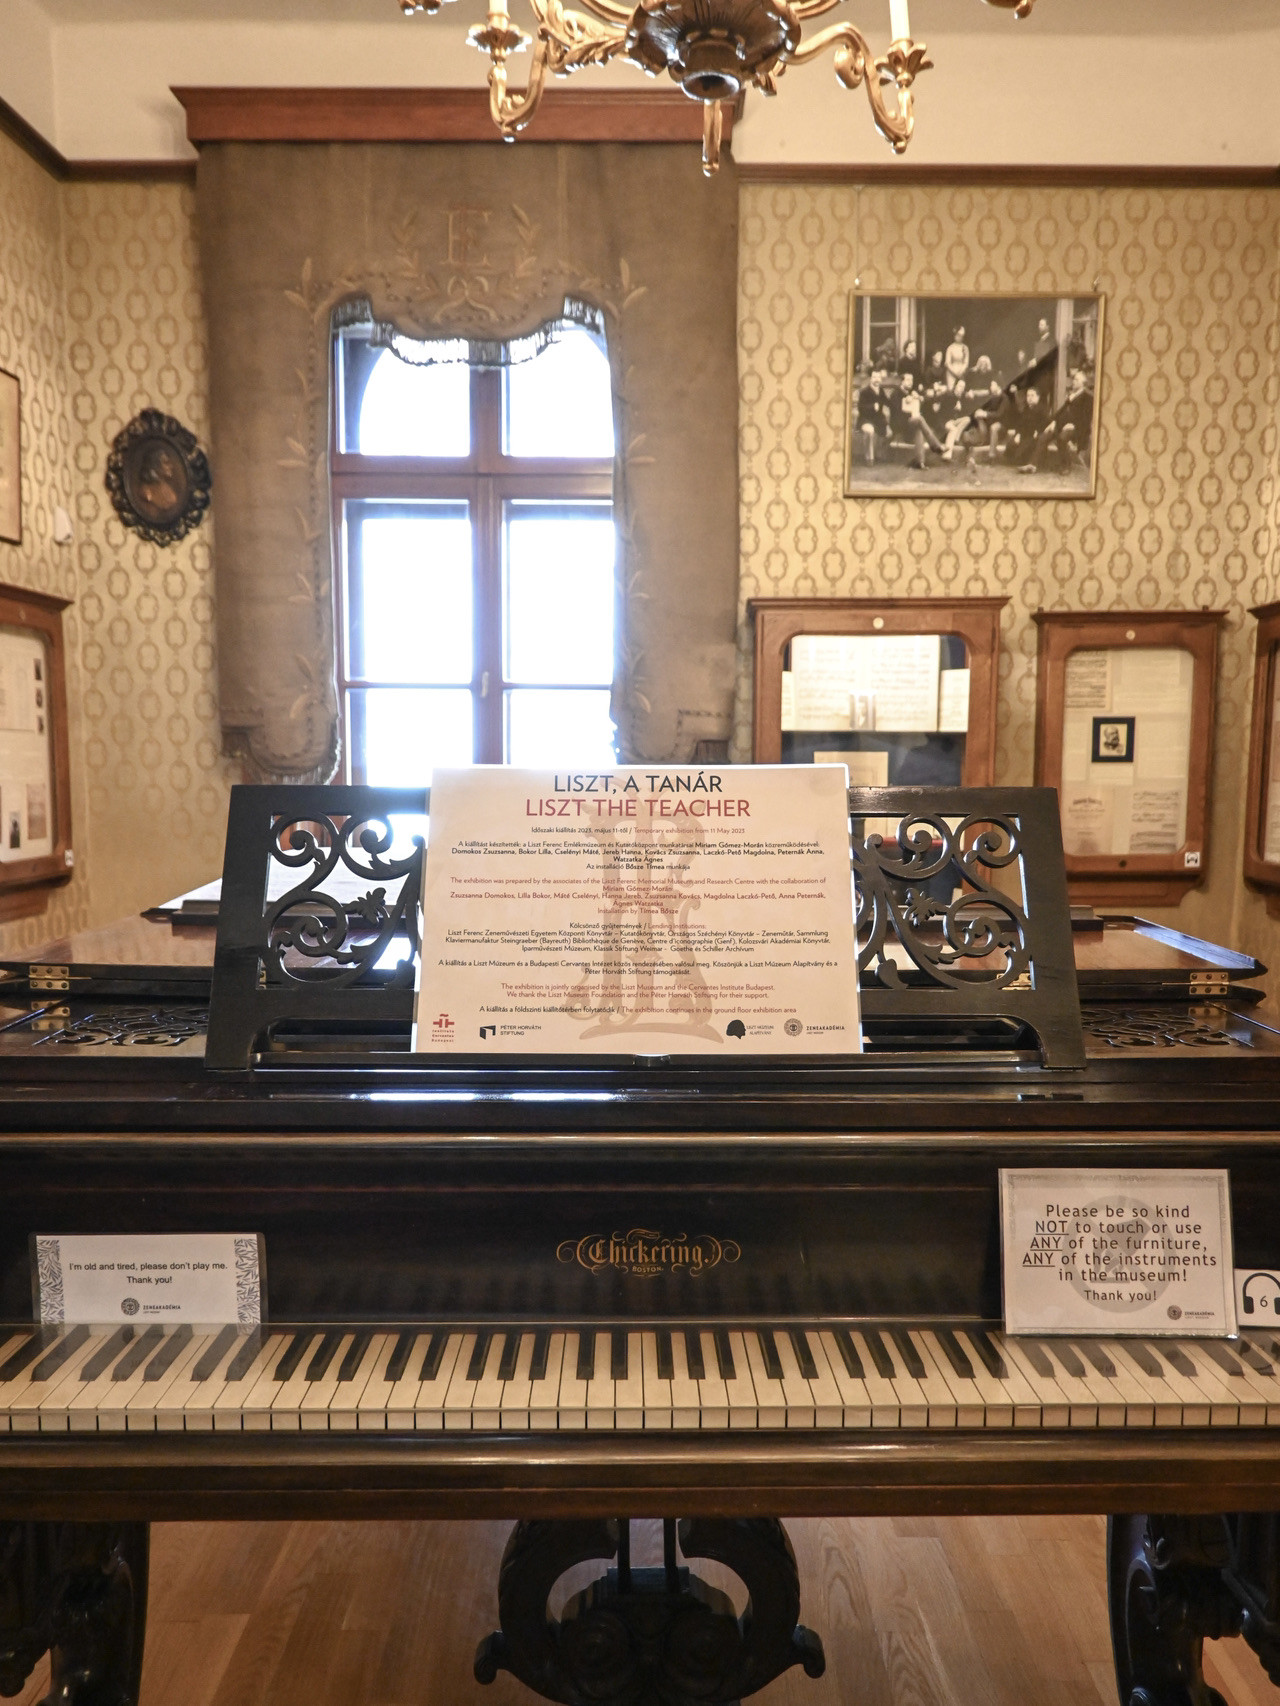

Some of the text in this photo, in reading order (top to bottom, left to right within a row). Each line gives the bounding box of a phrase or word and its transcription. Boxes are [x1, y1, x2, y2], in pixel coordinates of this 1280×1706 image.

[555, 772, 722, 795] LISZT, A TANÁR
[526, 799, 750, 817] LISZT THE TEACHER
[634, 827, 664, 835] Temporary
[717, 827, 730, 835] May
[555, 849, 581, 857] Cselényi
[643, 855, 663, 863] Ágnes
[666, 863, 690, 871] munkája
[505, 877, 532, 885] prepared
[704, 893, 735, 901] Magdolna
[613, 899, 633, 908] Ágnes
[648, 922, 673, 930] Lending
[531, 930, 557, 938] Egyetem
[558, 930, 585, 938] Központi
[586, 930, 613, 938] Könyvtár
[667, 930, 696, 938] Országos
[697, 930, 727, 938] Széchényi
[728, 930, 754, 938] Könyvtár
[796, 930, 828, 938] Sammlung
[501, 937, 538, 945] Steingraeber
[539, 937, 571, 945] (Bayreuth)
[572, 937, 610, 945] Bibliothèque
[669, 937, 713, 945] d'iconographie
[615, 945, 639, 953] Stiftung
[530, 960, 559, 968] Budapesti
[628, 968, 652, 976] Stiftung
[551, 983, 569, 991] jointly
[570, 983, 600, 991] organised
[694, 991, 718, 999] Stiftung
[714, 1006, 736, 1014] ground
[1046, 1205, 1189, 1217] Please be so kind
[1036, 1221, 1201, 1233] NOT to touch or use
[1030, 1237, 1206, 1250] ANY of the furniture,
[1023, 1253, 1216, 1265] ANY of the instruments
[69, 1261, 82, 1269] I'm
[84, 1261, 97, 1269] old
[99, 1261, 115, 1269] and
[117, 1261, 138, 1270] tired,
[140, 1262, 167, 1271] please
[170, 1262, 190, 1270] don't
[193, 1262, 210, 1271] play
[127, 1275, 172, 1284] Thank you!
[1059, 1270, 1186, 1281] in the museum!
[1085, 1290, 1156, 1304] Thank you!
[1260, 1296, 1268, 1308] 6
